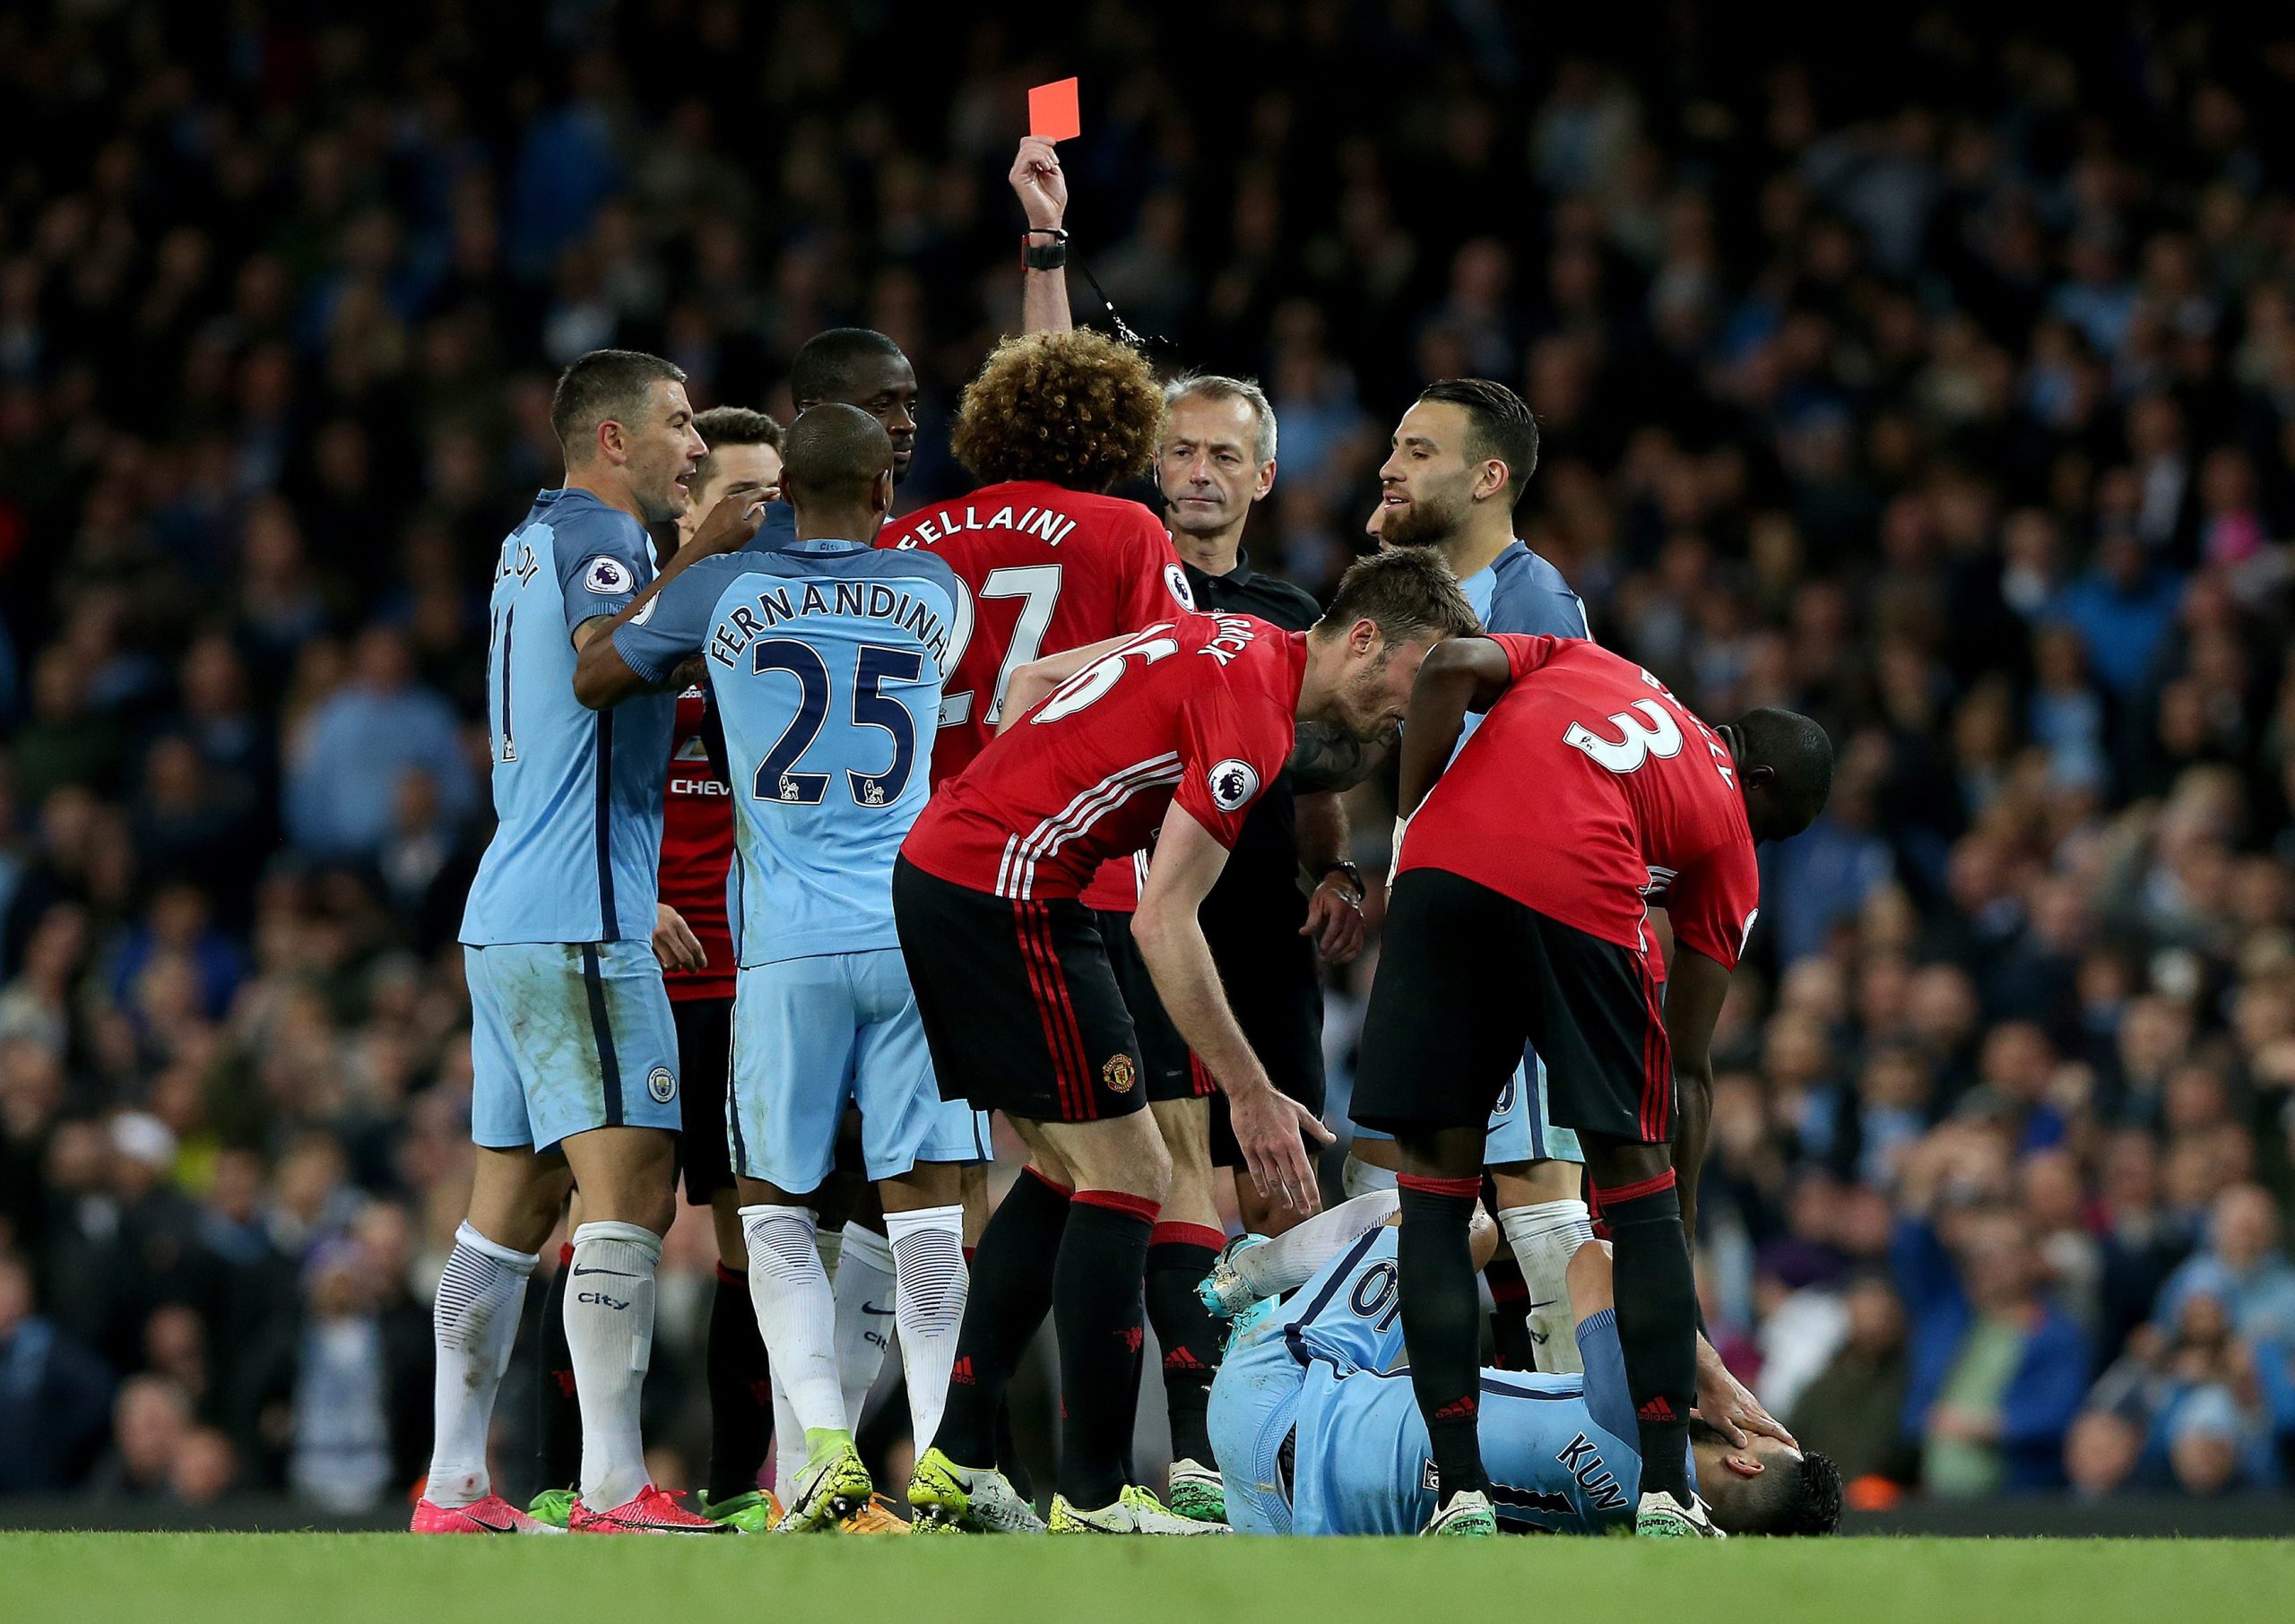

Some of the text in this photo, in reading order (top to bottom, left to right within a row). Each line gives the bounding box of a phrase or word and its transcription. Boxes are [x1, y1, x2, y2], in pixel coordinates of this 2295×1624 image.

[896, 505, 1077, 551] FELLAINI
[753, 637, 924, 809] 25
[1563, 697, 1684, 773] 3
[671, 779, 731, 796] CHEV
[1435, 1408, 1477, 1420] adida
[1637, 1412, 1677, 1421] adidas
[1555, 1430, 1629, 1511] KUN
